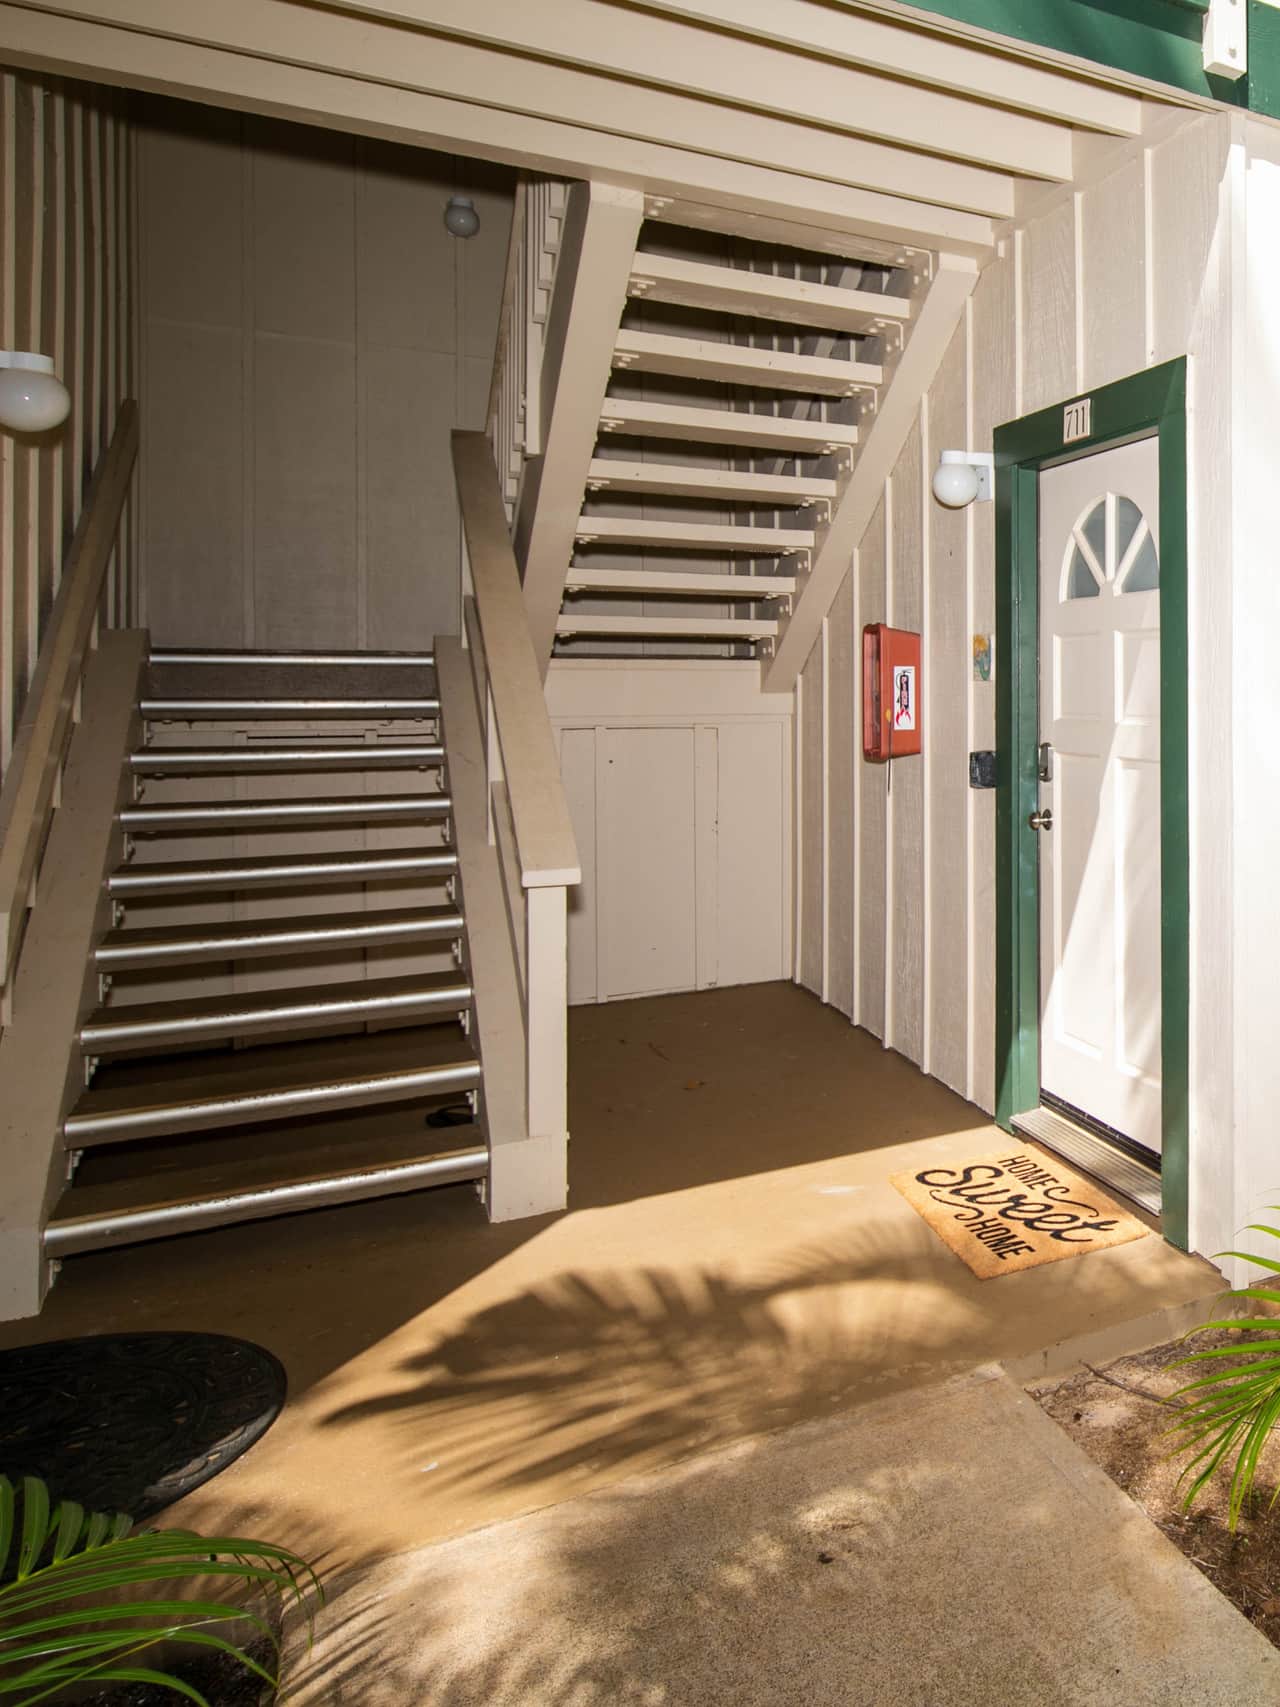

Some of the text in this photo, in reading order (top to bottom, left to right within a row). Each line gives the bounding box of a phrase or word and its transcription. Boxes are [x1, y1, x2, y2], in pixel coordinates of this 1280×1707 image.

[1065, 405, 1085, 439] 711
[997, 1155, 1060, 1190] HOME
[915, 1165, 1119, 1242] Sweet
[965, 1218, 1036, 1260] HOME
